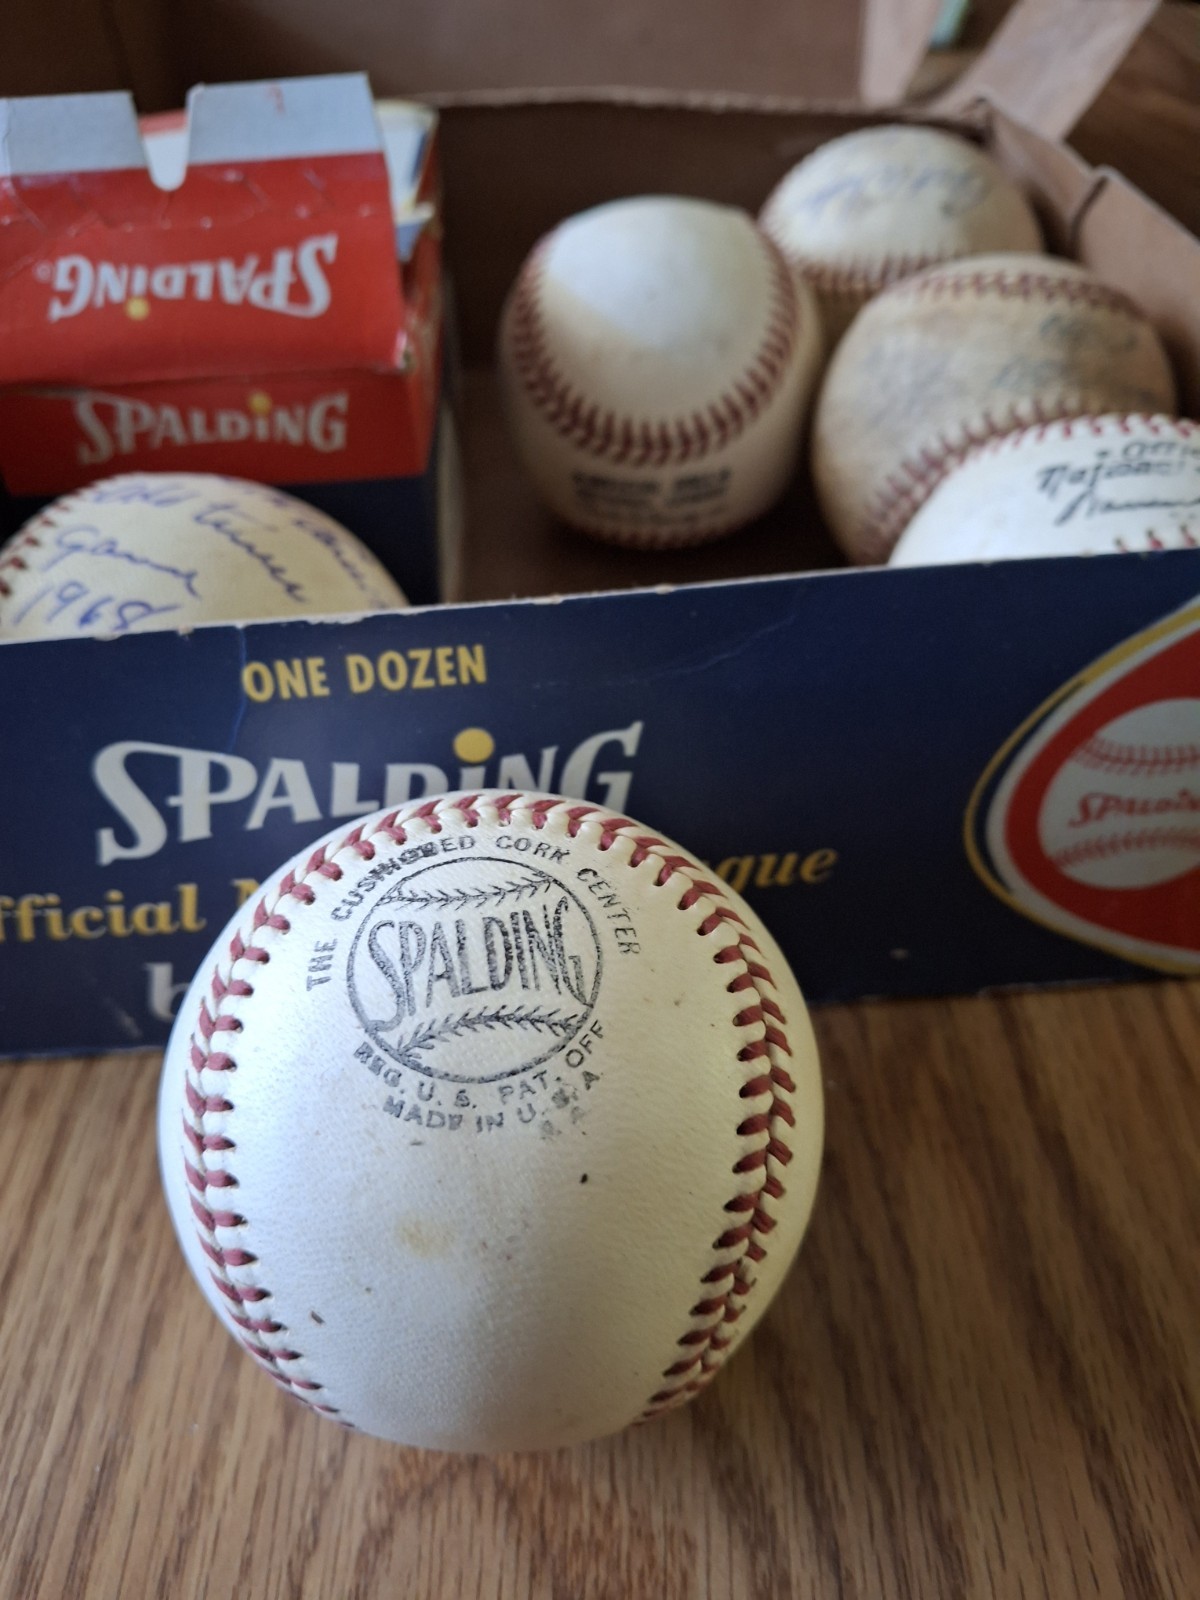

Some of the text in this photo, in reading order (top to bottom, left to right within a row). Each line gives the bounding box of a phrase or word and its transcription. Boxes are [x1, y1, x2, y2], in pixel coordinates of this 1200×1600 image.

[242, 644, 487, 702] ONE DOZEN
[306, 938, 338, 992] THE
[496, 834, 571, 865] CORK
[577, 867, 641, 956] CENTER
[367, 896, 593, 1032] SPALDING
[382, 1094, 464, 1132] MADE
[475, 1111, 506, 1133] IN
